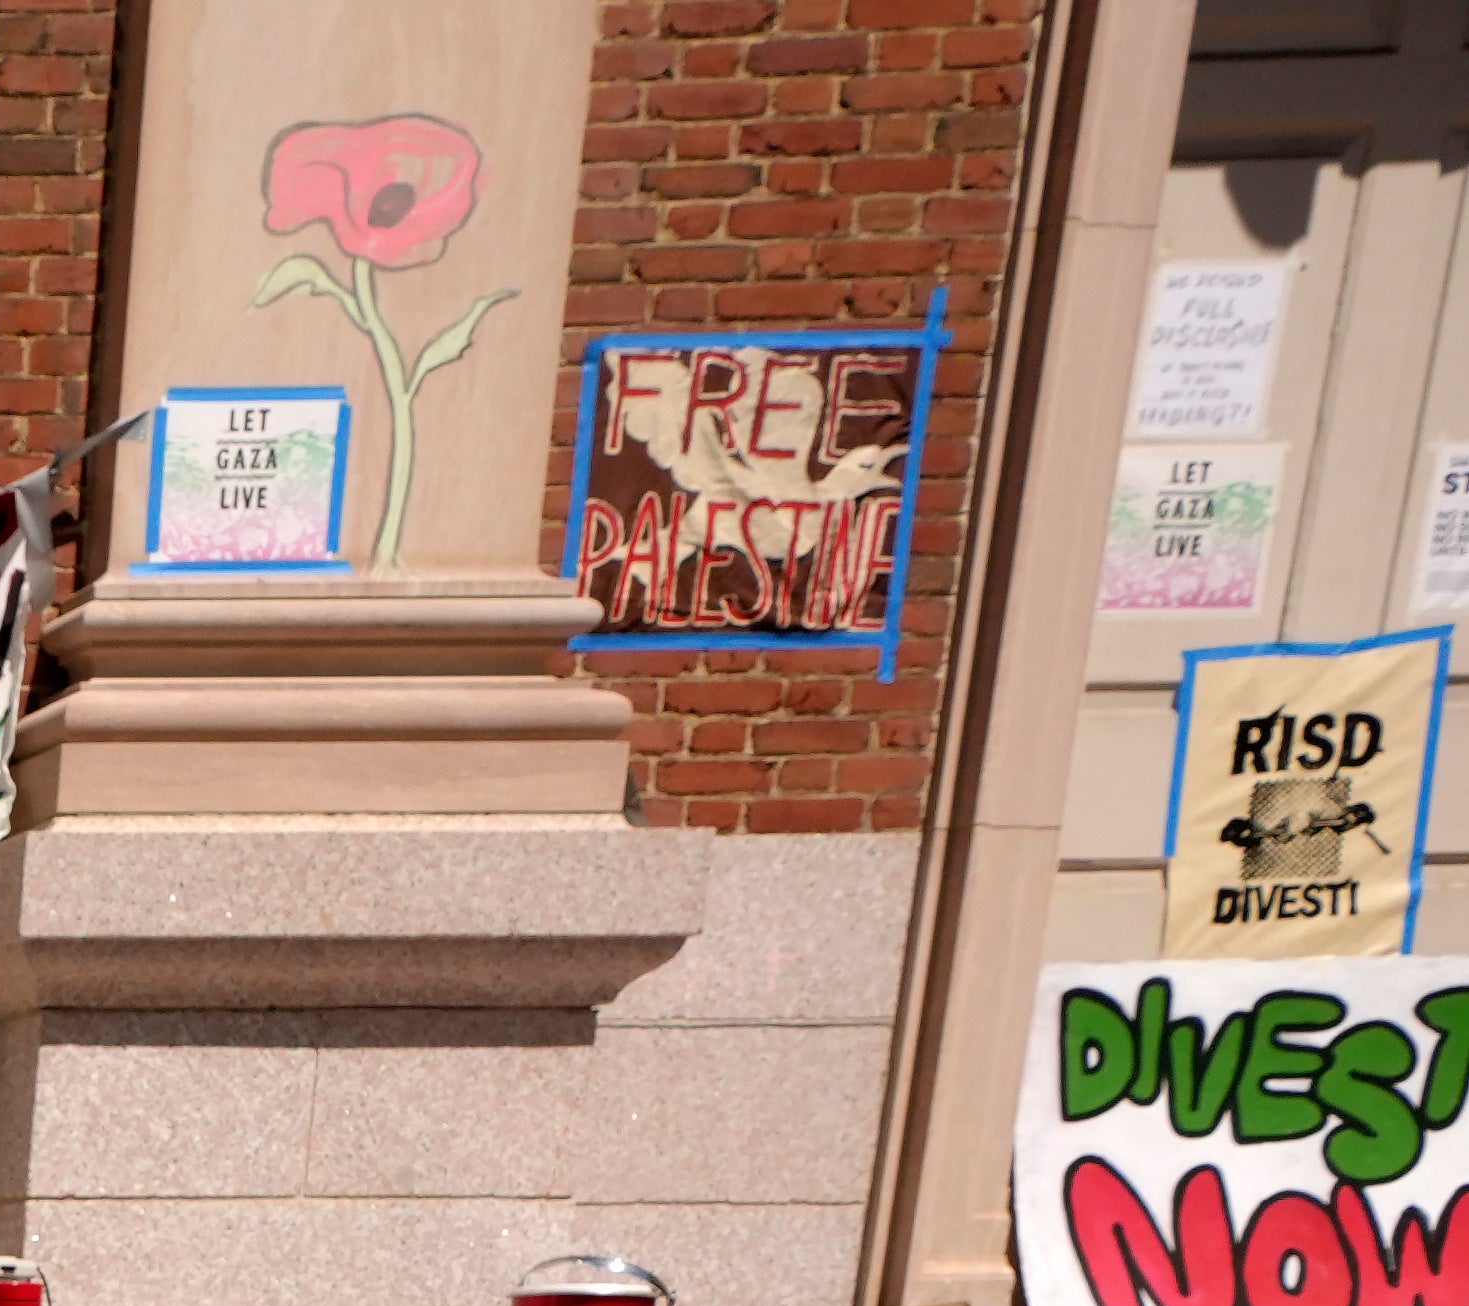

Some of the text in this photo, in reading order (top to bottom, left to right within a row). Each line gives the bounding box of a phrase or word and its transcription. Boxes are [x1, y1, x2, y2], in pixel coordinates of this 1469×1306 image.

[607, 351, 908, 459] FREE
[228, 409, 270, 433] LET
[216, 447, 278, 472] GAZA
[1170, 461, 1213, 484] LET
[220, 486, 266, 511] LIVE
[1155, 499, 1217, 520] GAZA
[1154, 534, 1203, 558] LIVE
[577, 496, 904, 631] PALESTINE
[1230, 704, 1385, 775] RISD
